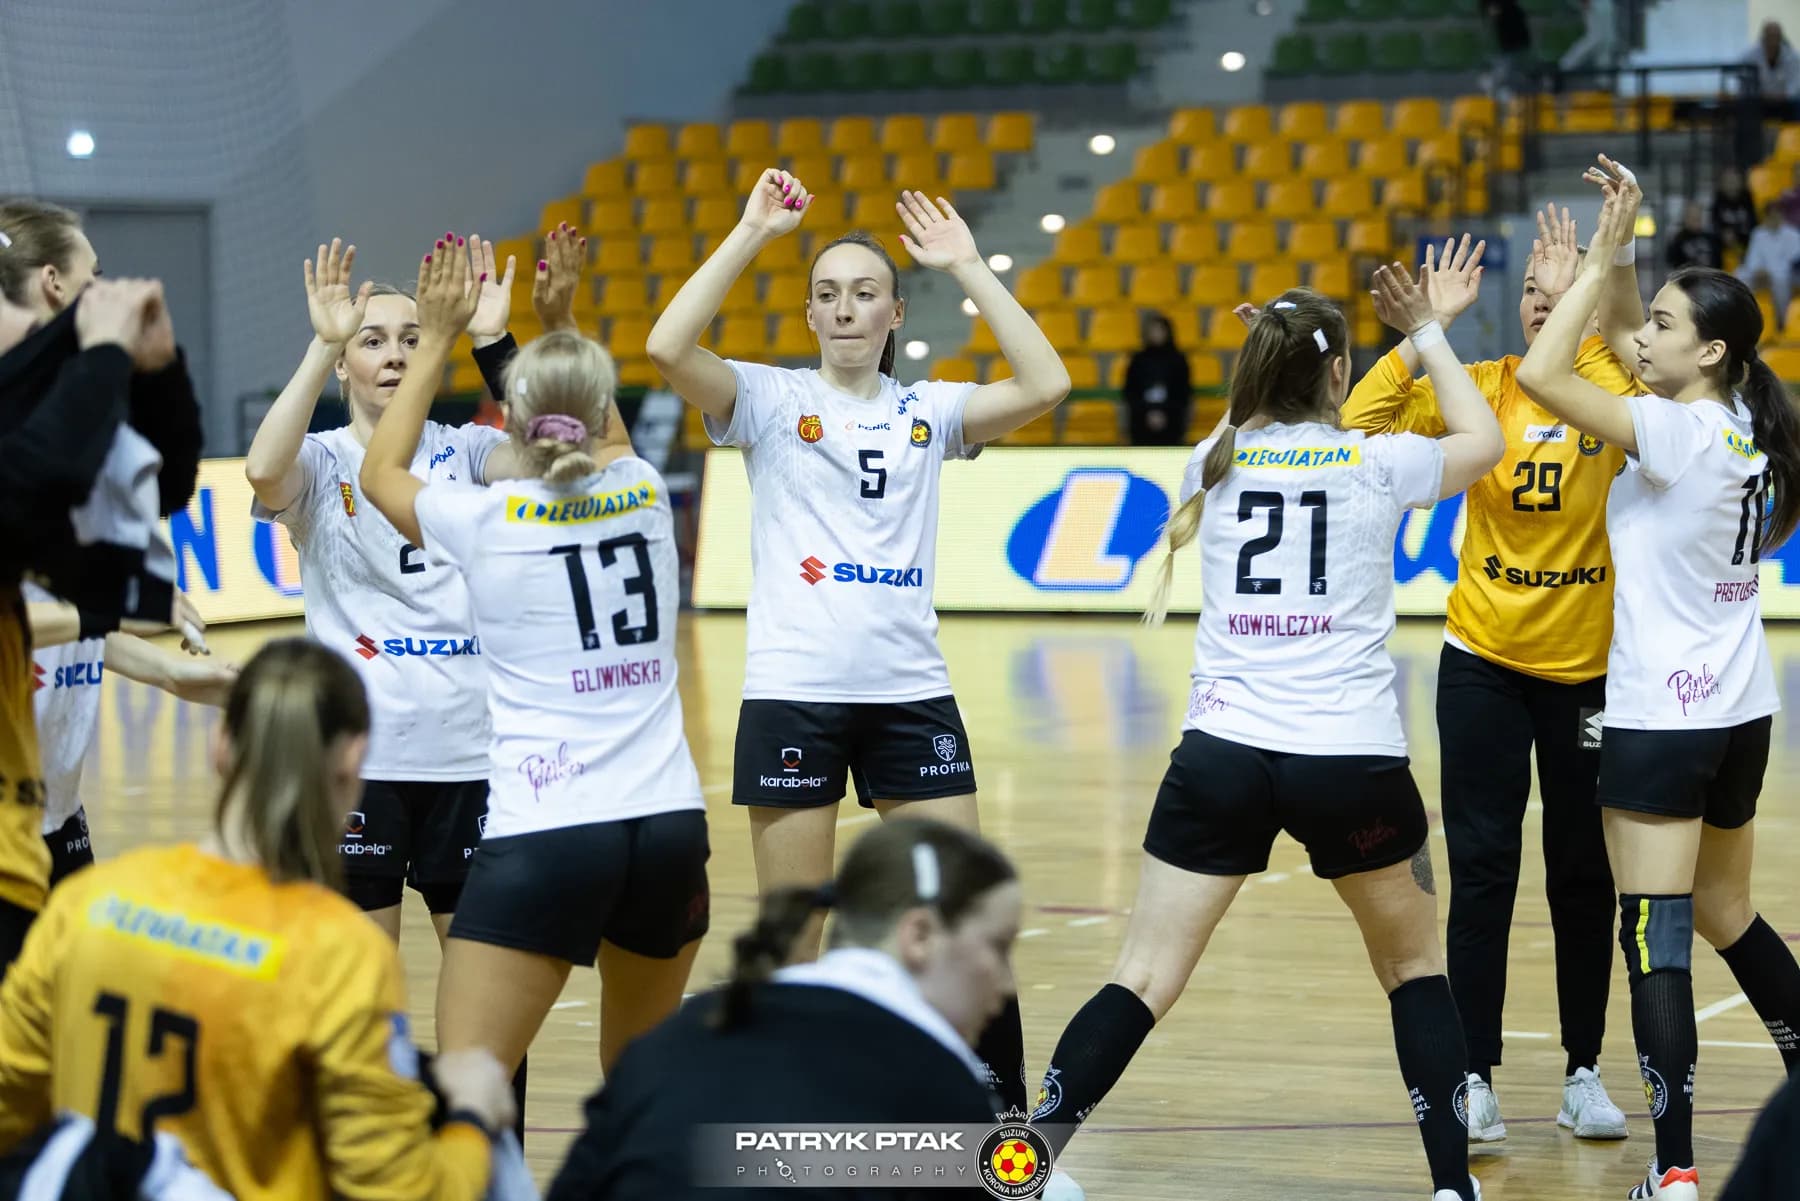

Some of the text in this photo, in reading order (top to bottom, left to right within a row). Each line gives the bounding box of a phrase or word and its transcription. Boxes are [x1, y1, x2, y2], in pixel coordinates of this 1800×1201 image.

[858, 449, 887, 499] 5
[1248, 448, 1351, 467] LEWIATAN
[549, 485, 650, 522] LEWIATAN
[1512, 461, 1563, 512] 29
[1235, 490, 1327, 595] 21
[549, 532, 659, 651] 13
[833, 563, 923, 587] SUZUKI
[1505, 566, 1606, 588] SUZUKI
[1228, 613, 1333, 637] KOWALCZYK
[572, 657, 661, 694] GLIWIŃSKA
[920, 761, 971, 777] PROFIKA
